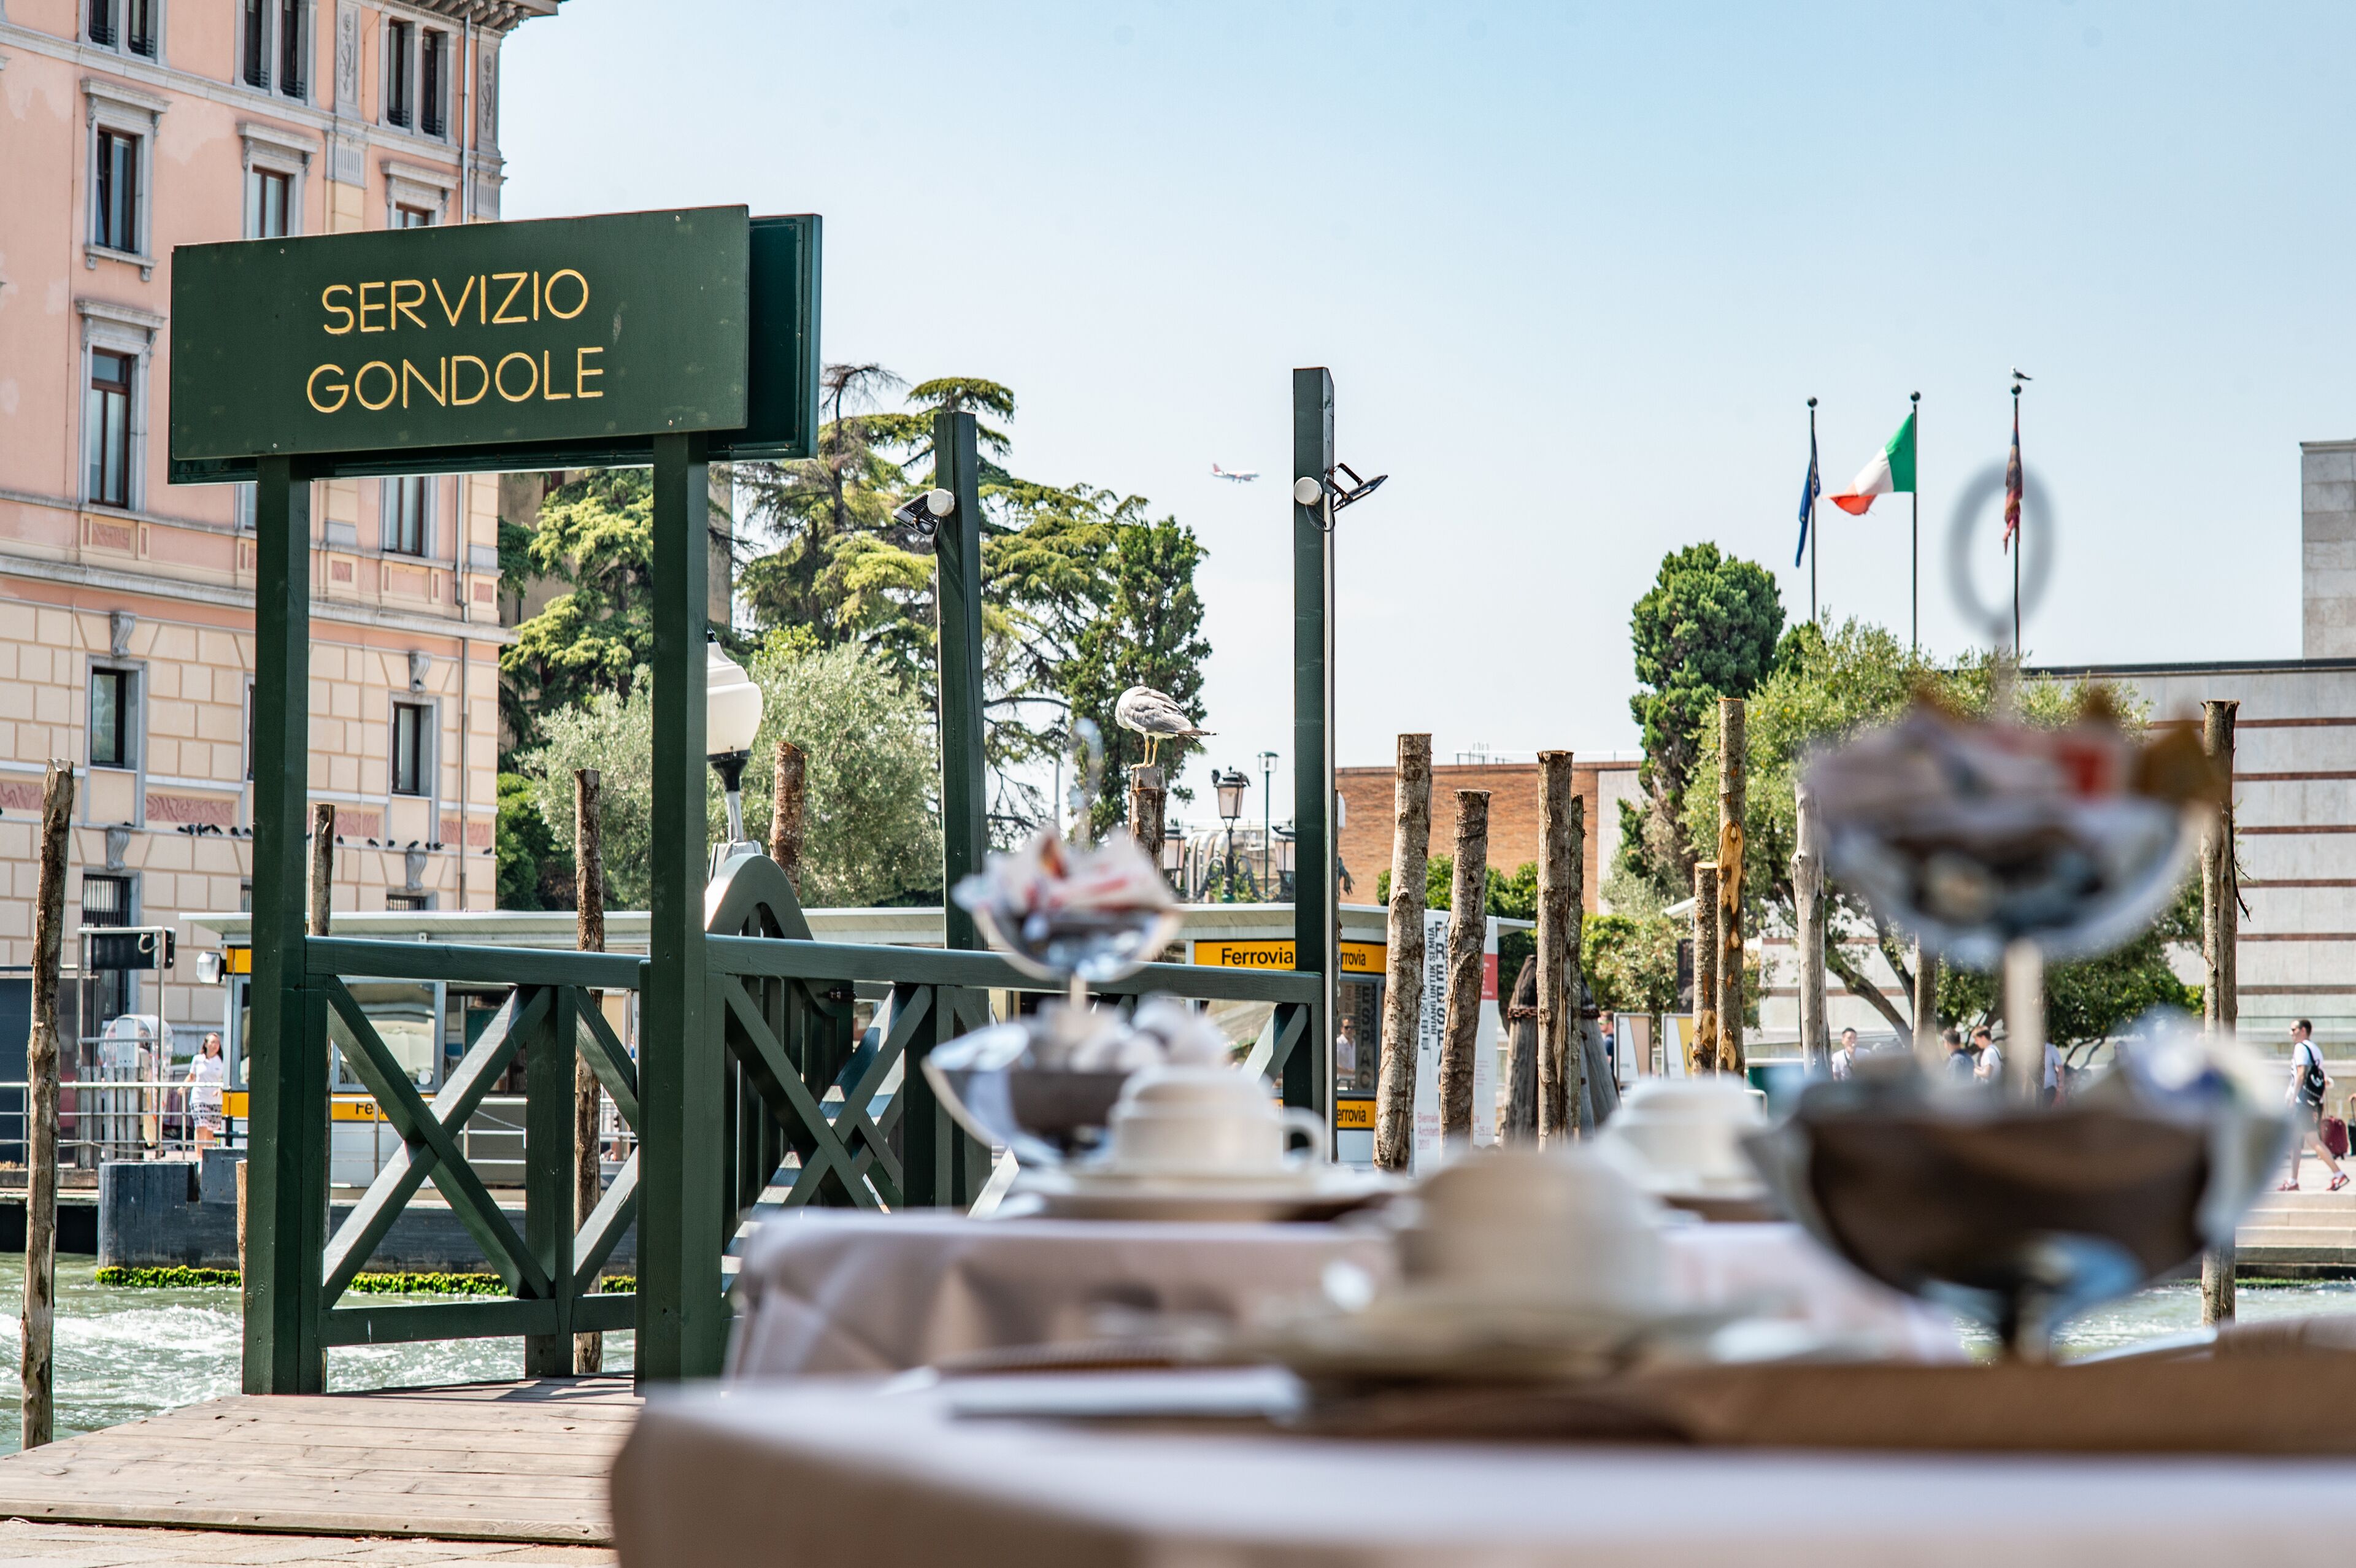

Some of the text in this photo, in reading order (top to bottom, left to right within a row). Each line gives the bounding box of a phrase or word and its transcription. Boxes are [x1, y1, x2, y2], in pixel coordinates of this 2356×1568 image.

[321, 269, 589, 334] SERVIZIO
[307, 347, 603, 413] GONDOLE
[1222, 947, 1293, 964] Ferrovia
[1341, 949, 1366, 966] rrovia
[1360, 985, 1370, 1088] ESPAC
[1435, 921, 1445, 1109] FREESP
[1337, 1105, 1366, 1123] errovia
